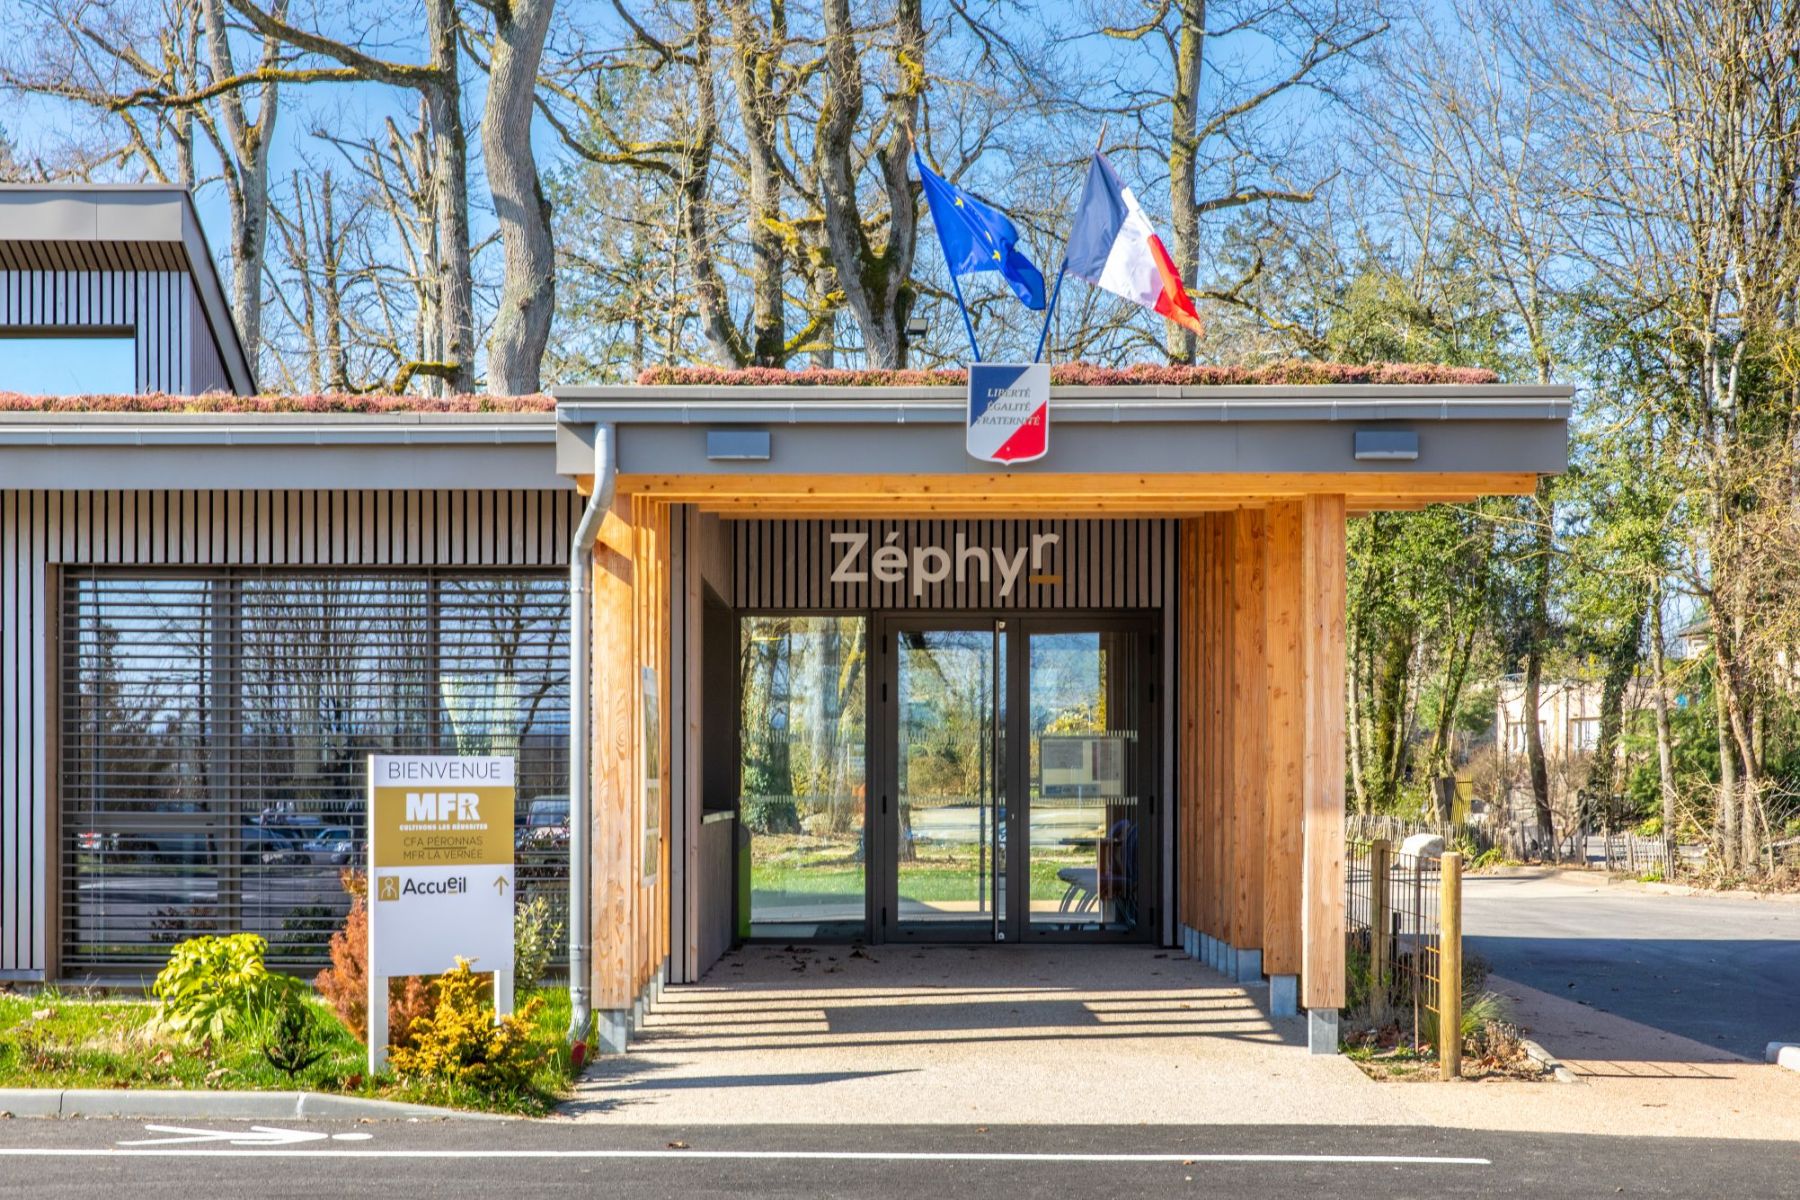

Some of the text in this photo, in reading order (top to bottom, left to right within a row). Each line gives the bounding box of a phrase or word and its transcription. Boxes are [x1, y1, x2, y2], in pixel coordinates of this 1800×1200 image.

[830, 532, 1060, 597] Zéphyr
[388, 761, 501, 780] BIENVENUE
[405, 793, 481, 821] MFR
[403, 834, 484, 847] CFA PÉRONNAS
[403, 848, 483, 860] MFR LA VERNÉE
[402, 876, 467, 895] Accueil
